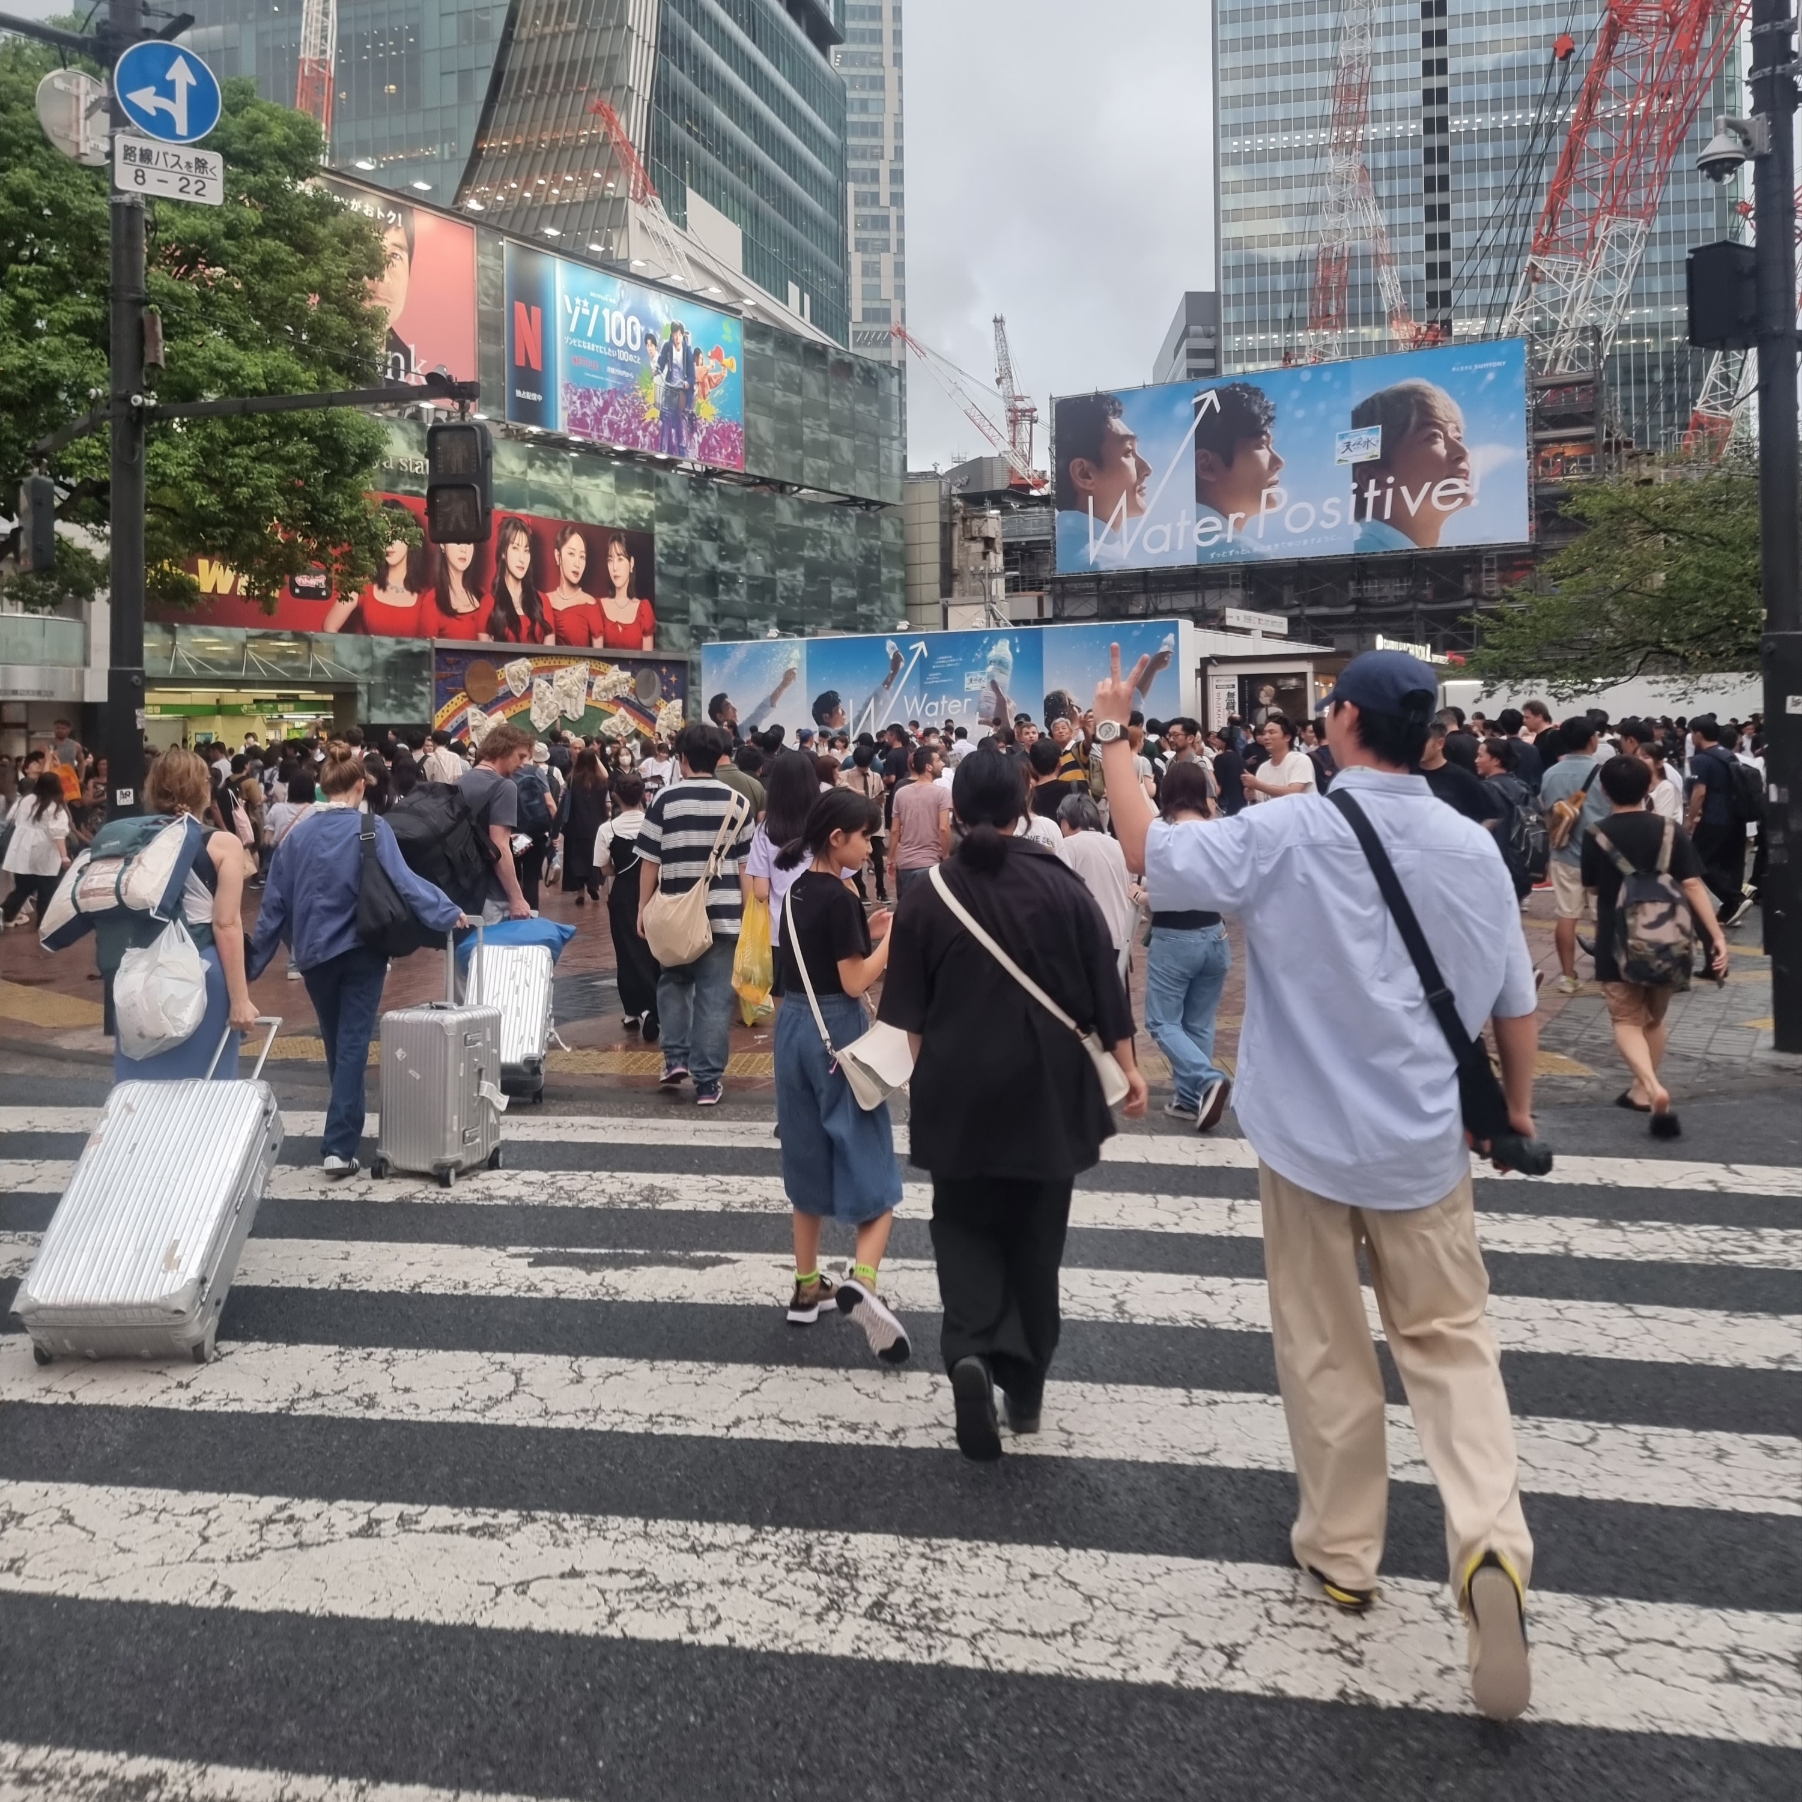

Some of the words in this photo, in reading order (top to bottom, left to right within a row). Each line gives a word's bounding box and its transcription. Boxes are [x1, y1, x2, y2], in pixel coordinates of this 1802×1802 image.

[123, 144, 217, 177] 路線バスを除く
[514, 300, 542, 372] N
[1088, 489, 1246, 567] Water
[1257, 450, 1480, 539] Positive!
[903, 693, 972, 718] Water
